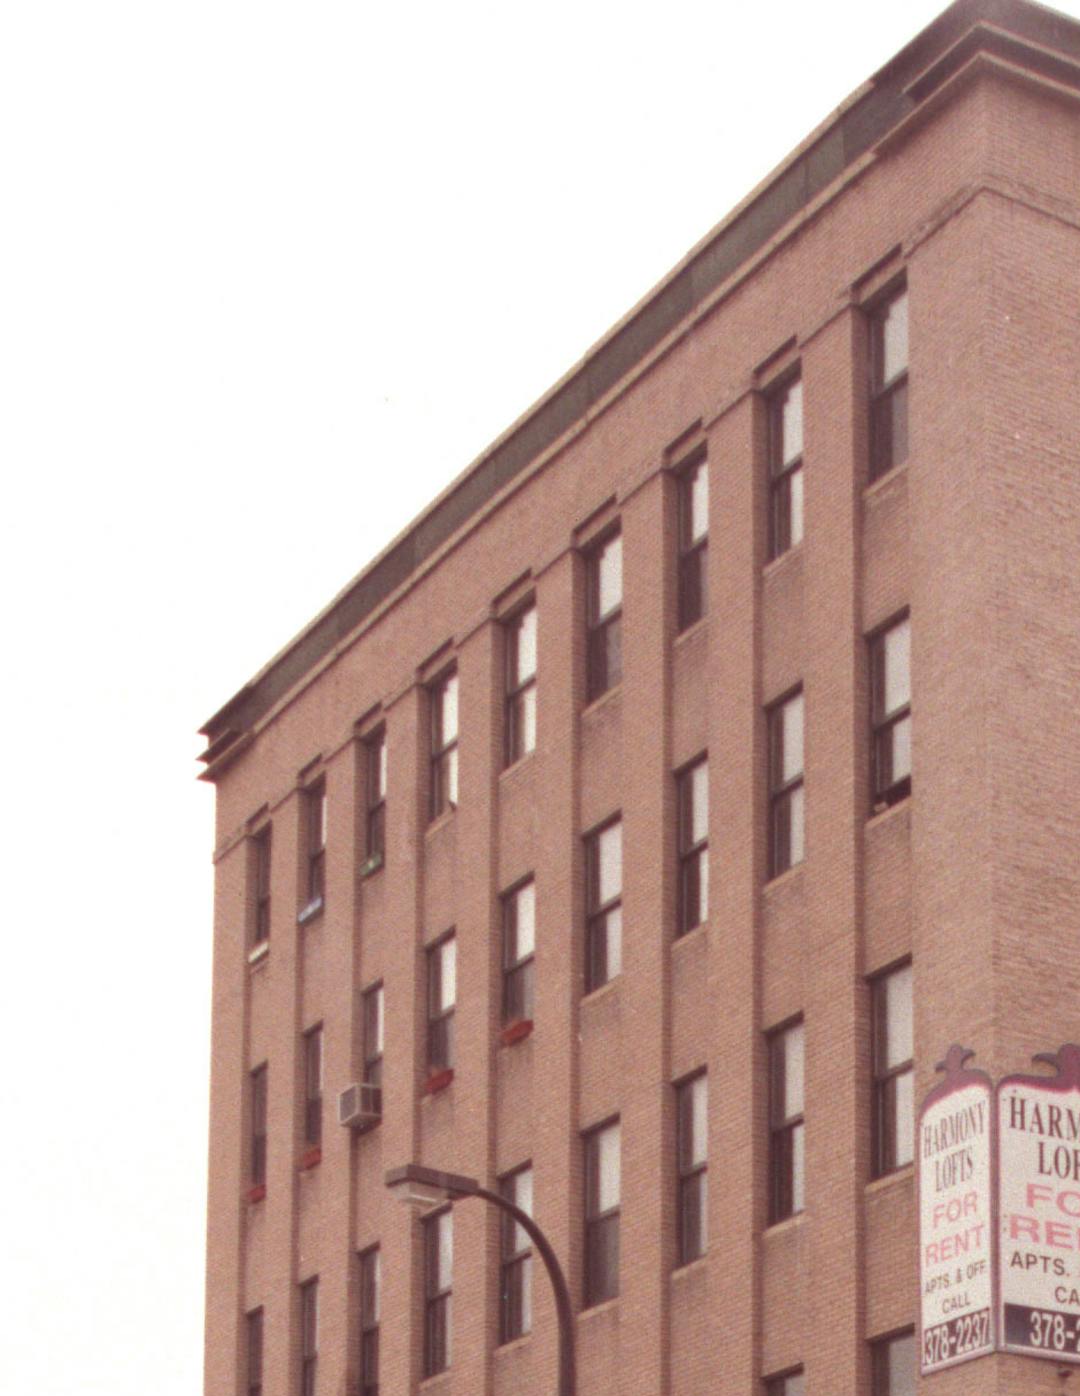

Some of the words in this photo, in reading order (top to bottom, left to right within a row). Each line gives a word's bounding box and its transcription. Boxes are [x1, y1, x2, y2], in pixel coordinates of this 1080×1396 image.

[935, 1145, 973, 1192] LOFTS
[932, 1190, 977, 1229] FOR
[925, 1225, 984, 1267] RENT
[1010, 1250, 1070, 1277] APTS.
[942, 1292, 971, 1314] CALL
[925, 1312, 989, 1365] 378-2237
